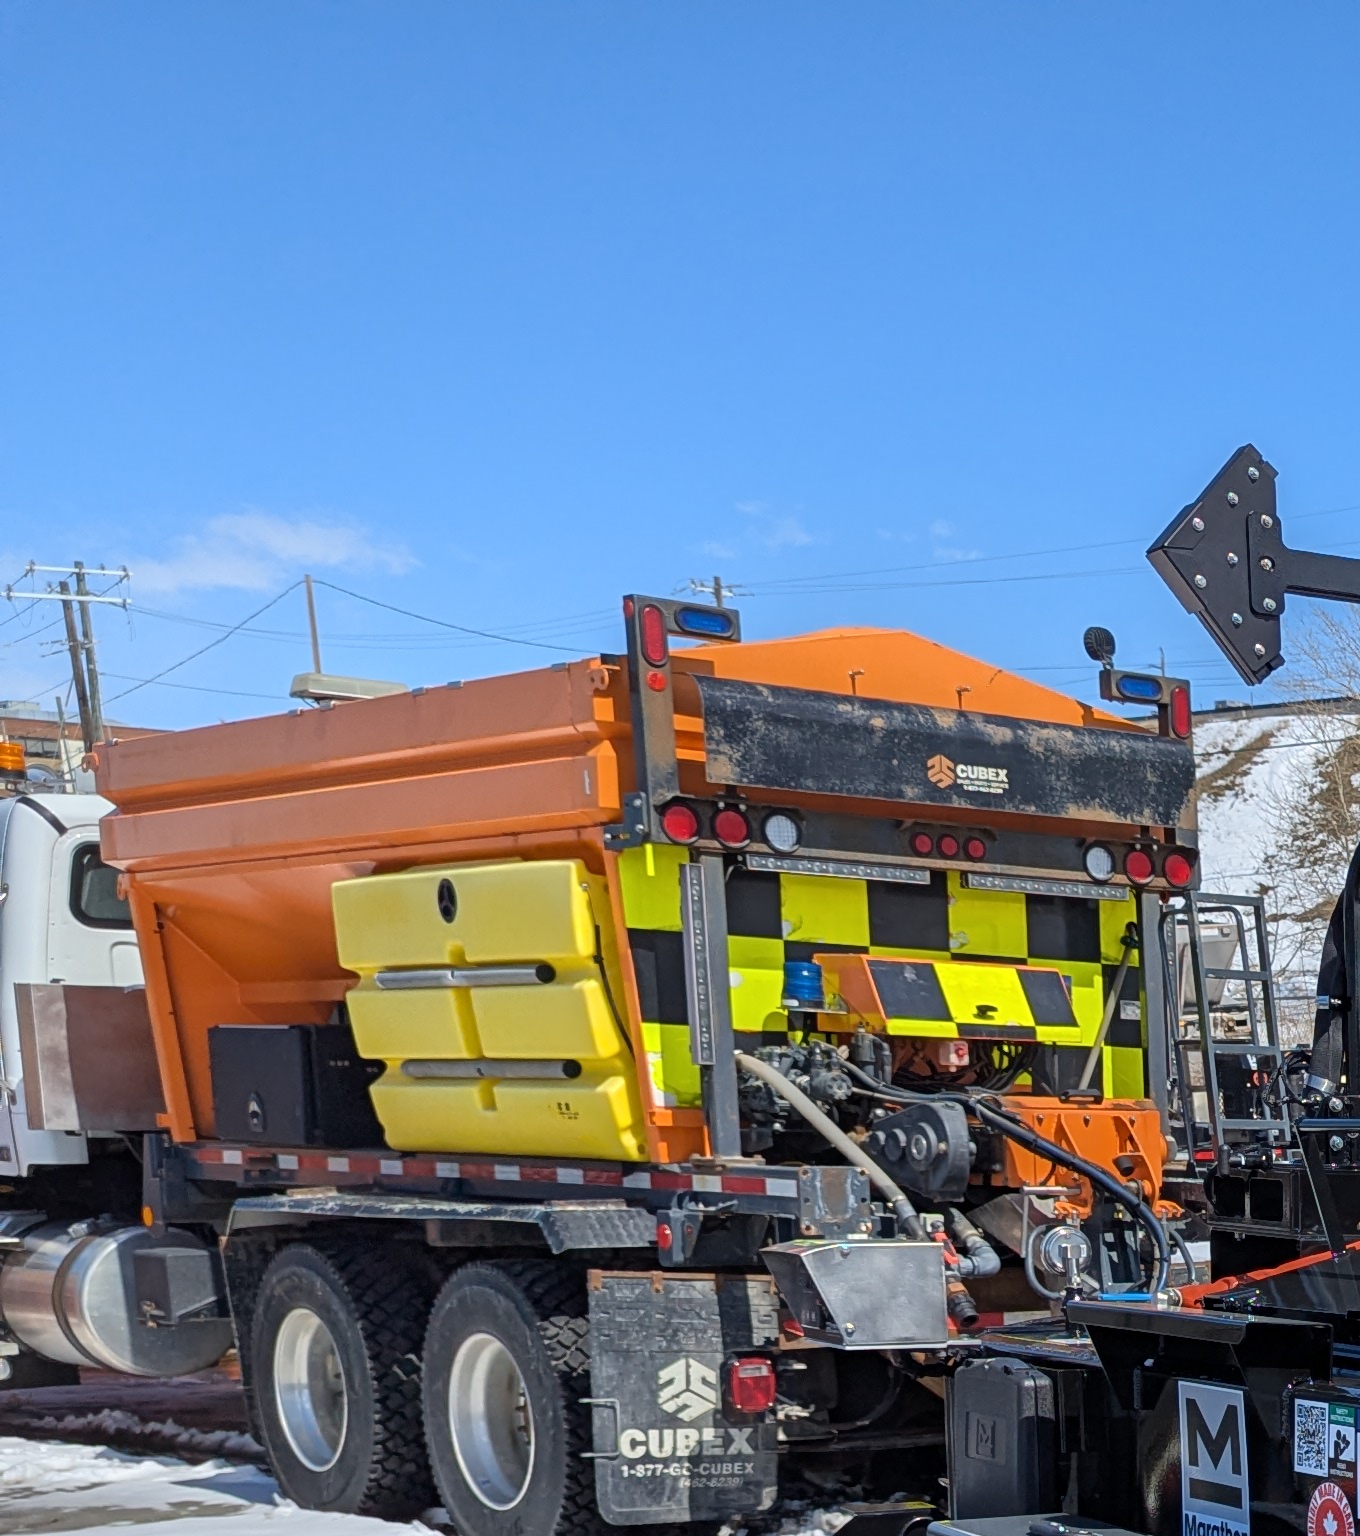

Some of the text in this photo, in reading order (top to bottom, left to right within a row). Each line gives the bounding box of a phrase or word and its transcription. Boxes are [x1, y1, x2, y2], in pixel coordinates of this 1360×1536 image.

[956, 764, 1008, 782] CUBEX
[620, 1428, 755, 1459] CUBEX
[1186, 1397, 1242, 1476] M
[621, 1462, 755, 1477] 1-877-GO-CUBEX
[1318, 1483, 1336, 1501] MADE
